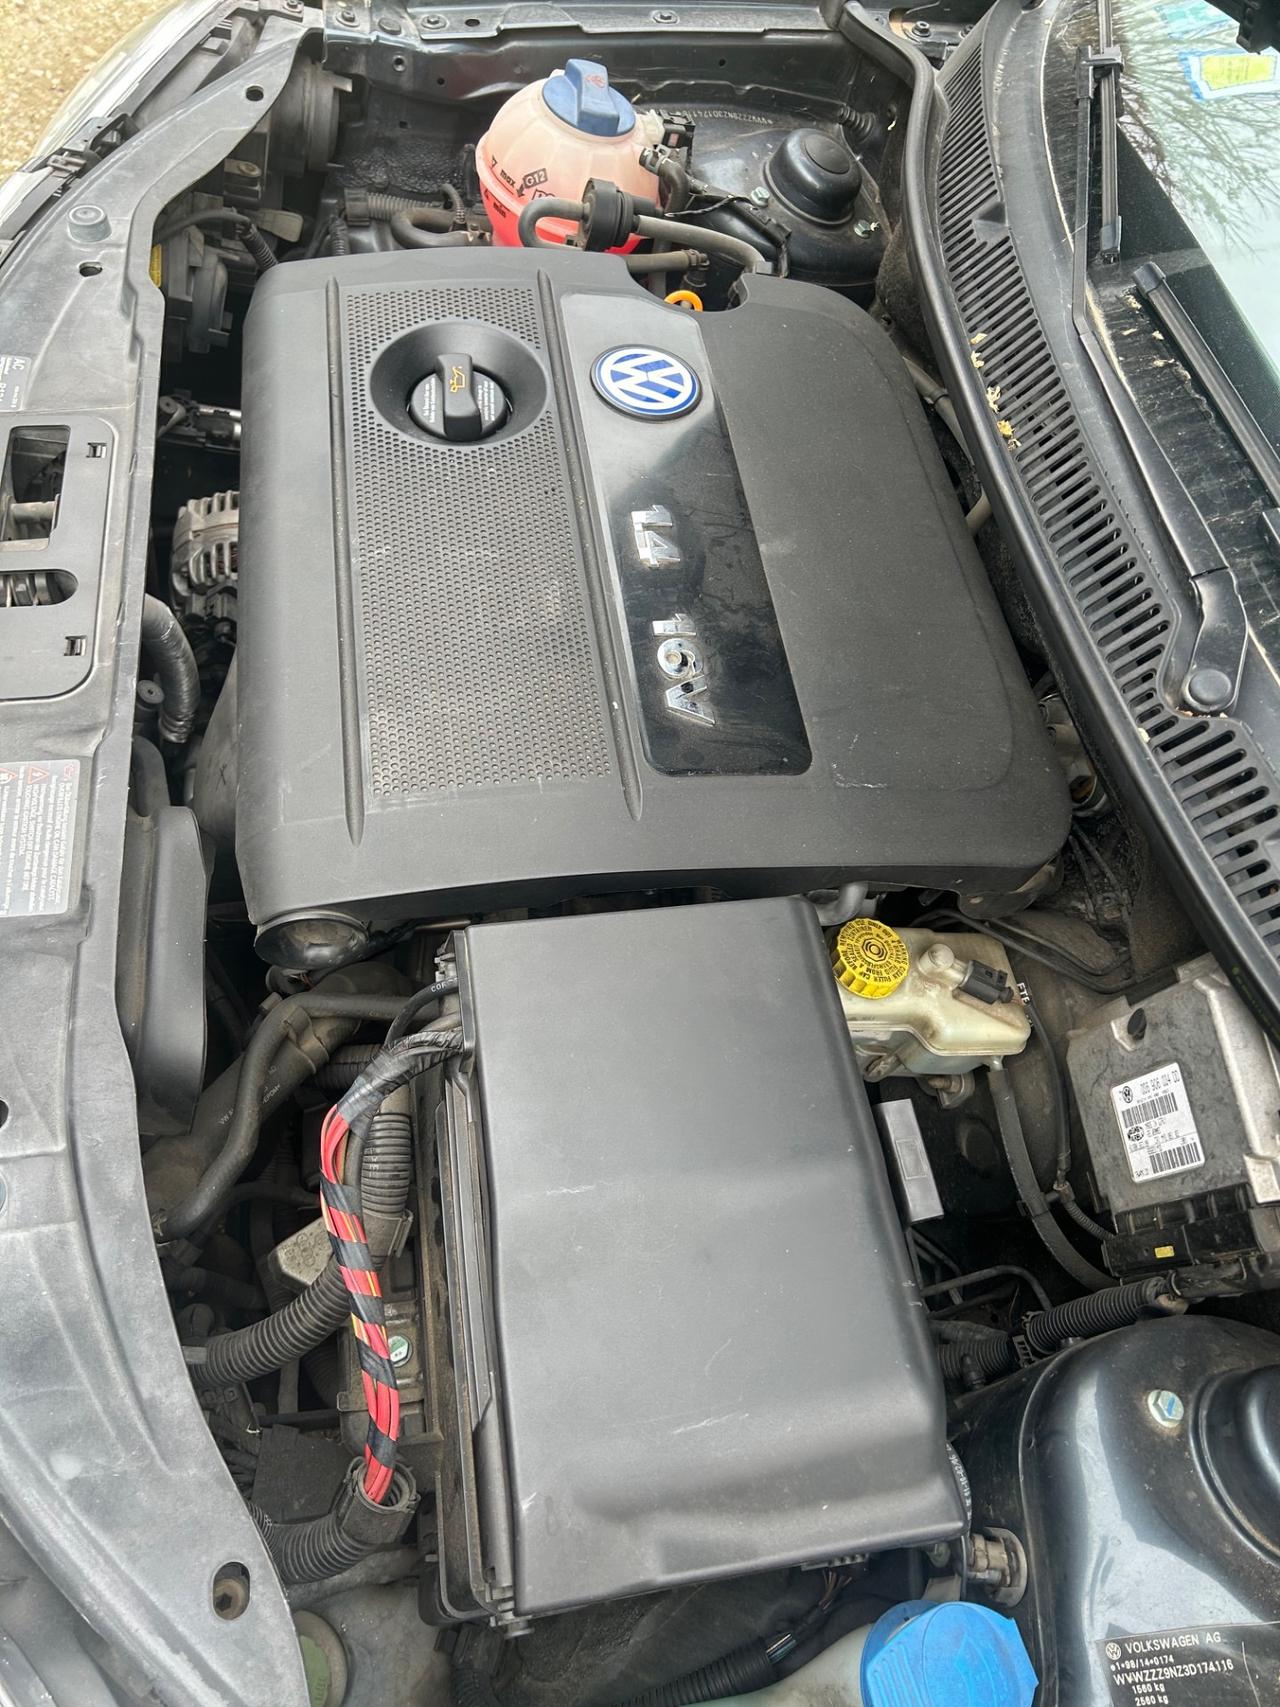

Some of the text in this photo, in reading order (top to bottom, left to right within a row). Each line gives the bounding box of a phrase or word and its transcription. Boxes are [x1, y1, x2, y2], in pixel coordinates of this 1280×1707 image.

[500, 168, 516, 188] max
[525, 171, 546, 186] G12
[651, 612, 717, 728] 16V
[841, 950, 857, 970] BEFORE
[859, 971, 871, 980] CAP
[894, 966, 906, 979] CLEAN
[1125, 1631, 1222, 1654] VOLKSWAGEN AG
[1113, 1658, 1234, 1686] WVWZZZ9NZ3D174116
[1154, 1682, 1166, 1693] kg
[1157, 1694, 1169, 1705] kg
